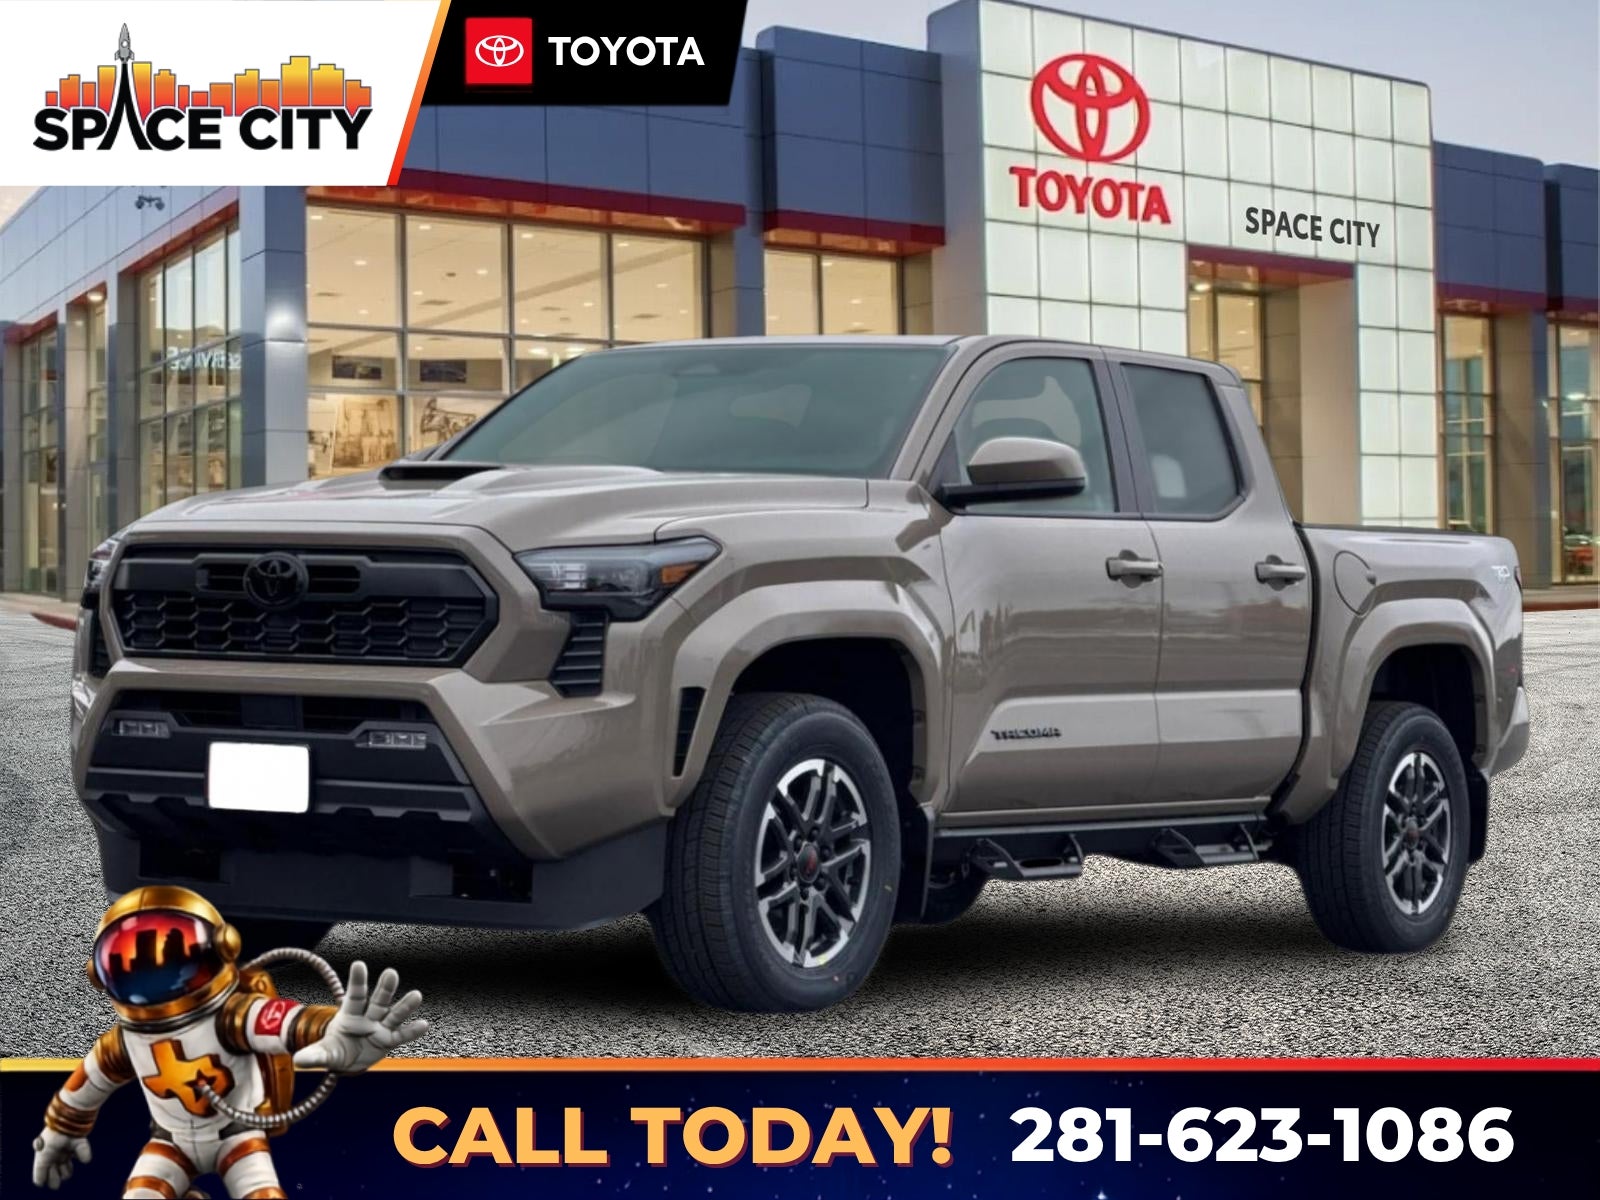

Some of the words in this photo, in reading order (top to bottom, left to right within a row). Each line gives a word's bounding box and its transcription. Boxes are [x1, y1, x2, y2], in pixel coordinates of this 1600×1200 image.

[1011, 165, 1171, 224] TOYOTA
[1246, 207, 1322, 241] SPACE
[1329, 218, 1380, 247] CITY
[990, 727, 1062, 741] TACOMA
